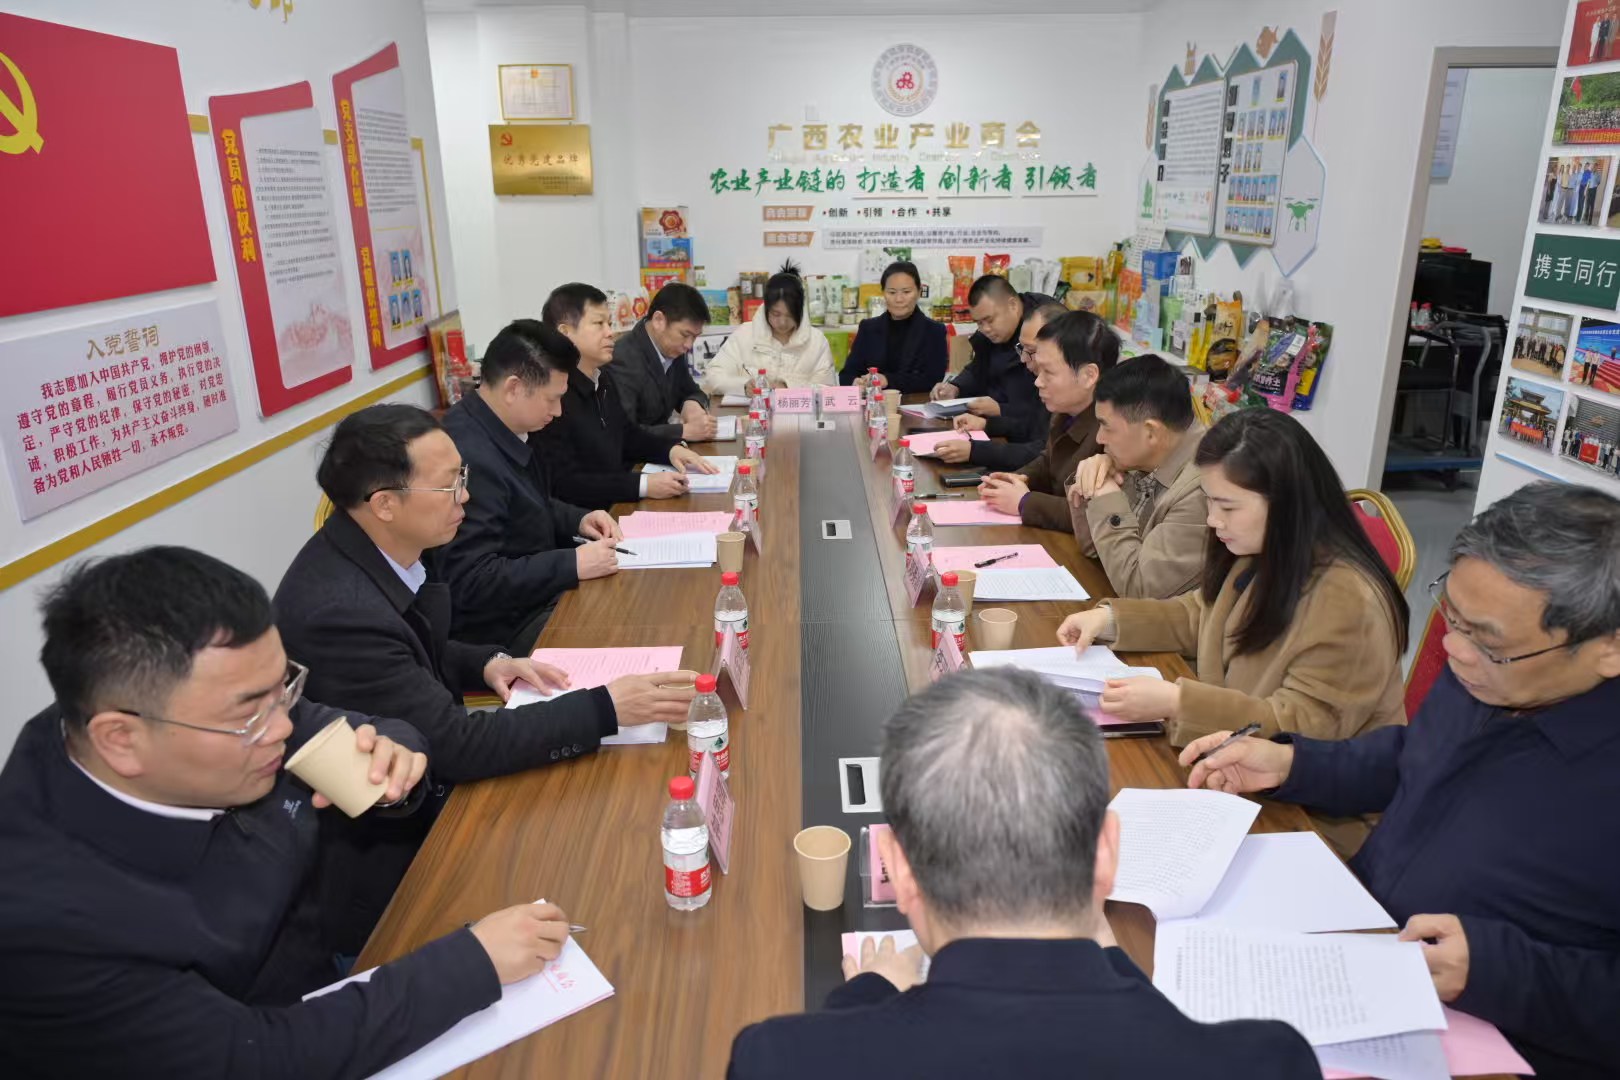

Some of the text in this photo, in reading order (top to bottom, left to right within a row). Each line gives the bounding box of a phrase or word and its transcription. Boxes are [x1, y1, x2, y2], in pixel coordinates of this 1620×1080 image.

[767, 121, 1042, 151] 广西农业产业商会
[708, 162, 1098, 197] 农业产业链的 打造者 创新者 引领者
[828, 207, 951, 218] 创新 引领 合作 共享
[1533, 253, 1618, 289] 携手同行
[86, 324, 161, 360] 入党誓词
[777, 397, 812, 409] 杨丽芳
